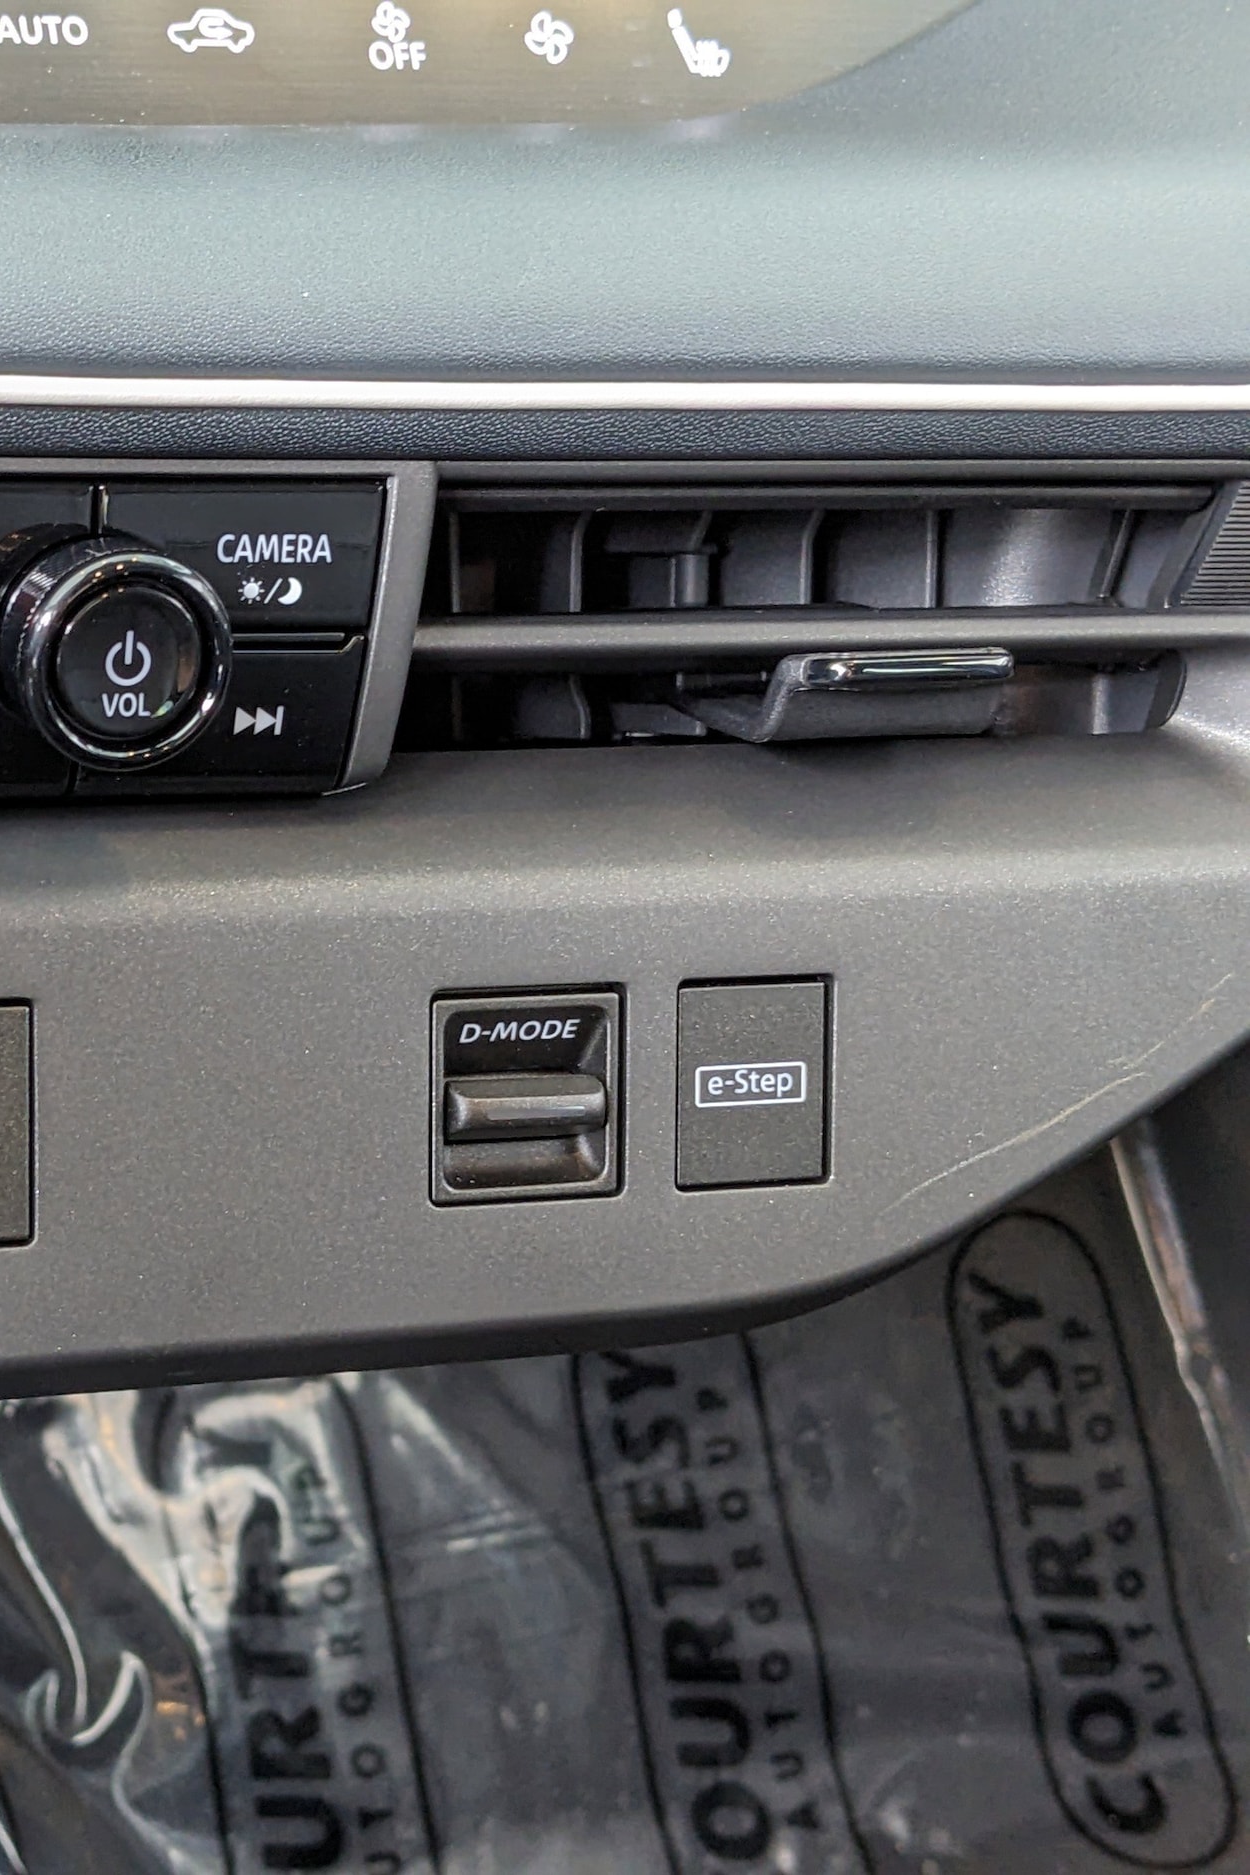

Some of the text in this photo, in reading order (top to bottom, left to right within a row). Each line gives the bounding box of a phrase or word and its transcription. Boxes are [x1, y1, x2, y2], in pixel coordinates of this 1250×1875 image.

[368, 41, 426, 70] OFF
[216, 534, 332, 563] CAMERA
[102, 693, 151, 717] VOL
[459, 1018, 580, 1044] D-MODE
[707, 1069, 793, 1098] e-Step
[969, 1272, 1166, 1834] COURTESY
[598, 1351, 772, 1875] OURTESY
